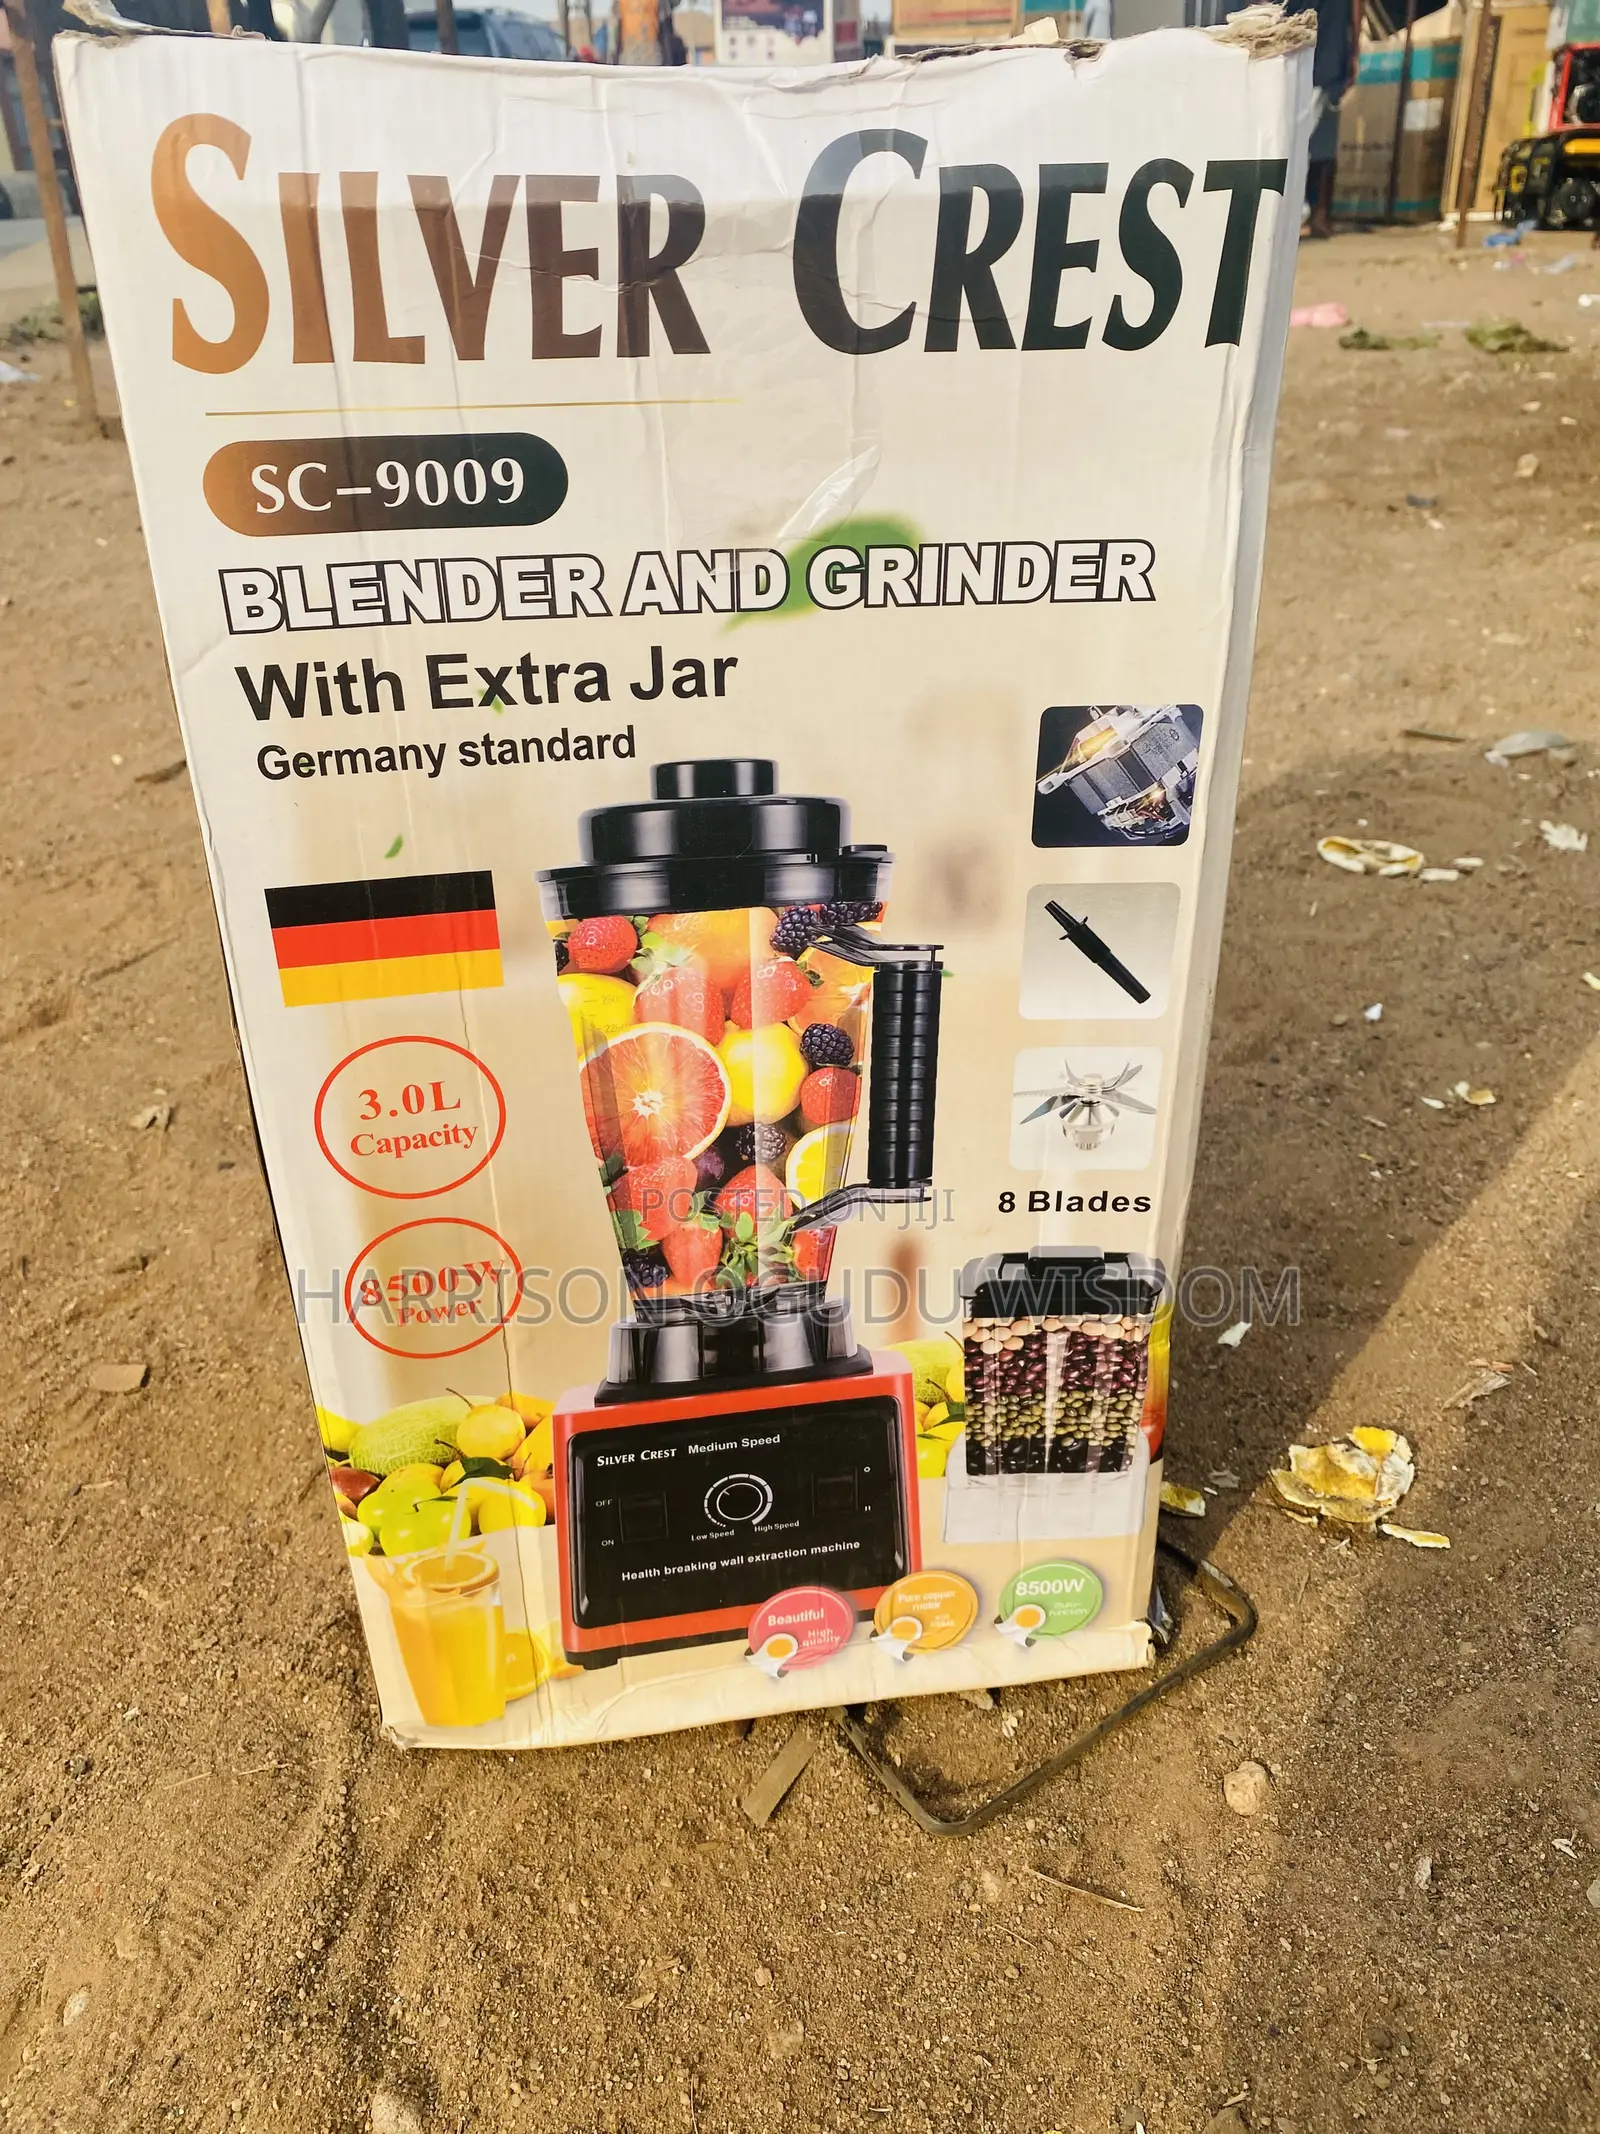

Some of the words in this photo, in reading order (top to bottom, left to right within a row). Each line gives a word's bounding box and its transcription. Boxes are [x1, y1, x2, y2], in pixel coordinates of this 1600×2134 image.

[151, 112, 711, 374] SILVER
[794, 128, 1288, 356] CREST
[218, 553, 613, 635] BLENDER
[620, 548, 791, 616] AND
[805, 538, 1156, 610] GRINDER
[235, 659, 404, 721] With
[426, 652, 611, 710] Extra
[630, 645, 738, 701] Jar
[257, 742, 446, 781] Germany
[459, 725, 636, 767] standard
[358, 1080, 461, 1121] 3.0L
[350, 1123, 478, 1158] Capacity
[998, 1190, 1016, 1213] 8
[1028, 1190, 1152, 1212] Blades
[359, 1258, 506, 1307] 8500W
[396, 1298, 482, 1327] Power
[688, 1438, 738, 1455] Medium
[741, 1434, 780, 1448] Speed
[597, 1453, 635, 1467] SILVER
[640, 1448, 677, 1461] CREST
[595, 1499, 613, 1507] OFF
[691, 1532, 708, 1541] Low
[709, 1529, 735, 1540] Speed
[754, 1523, 773, 1533] High
[774, 1520, 800, 1531] Speed
[601, 1539, 615, 1547] ON
[621, 1566, 661, 1581] Health
[664, 1559, 717, 1576] breaking
[720, 1555, 744, 1567] wall
[747, 1547, 807, 1564] extraction
[810, 1539, 861, 1555] machine
[1016, 1578, 1086, 1597] 8500W
[768, 1607, 825, 1627] Beautiful
[802, 1634, 841, 1648] quality
[808, 1627, 833, 1639] High
